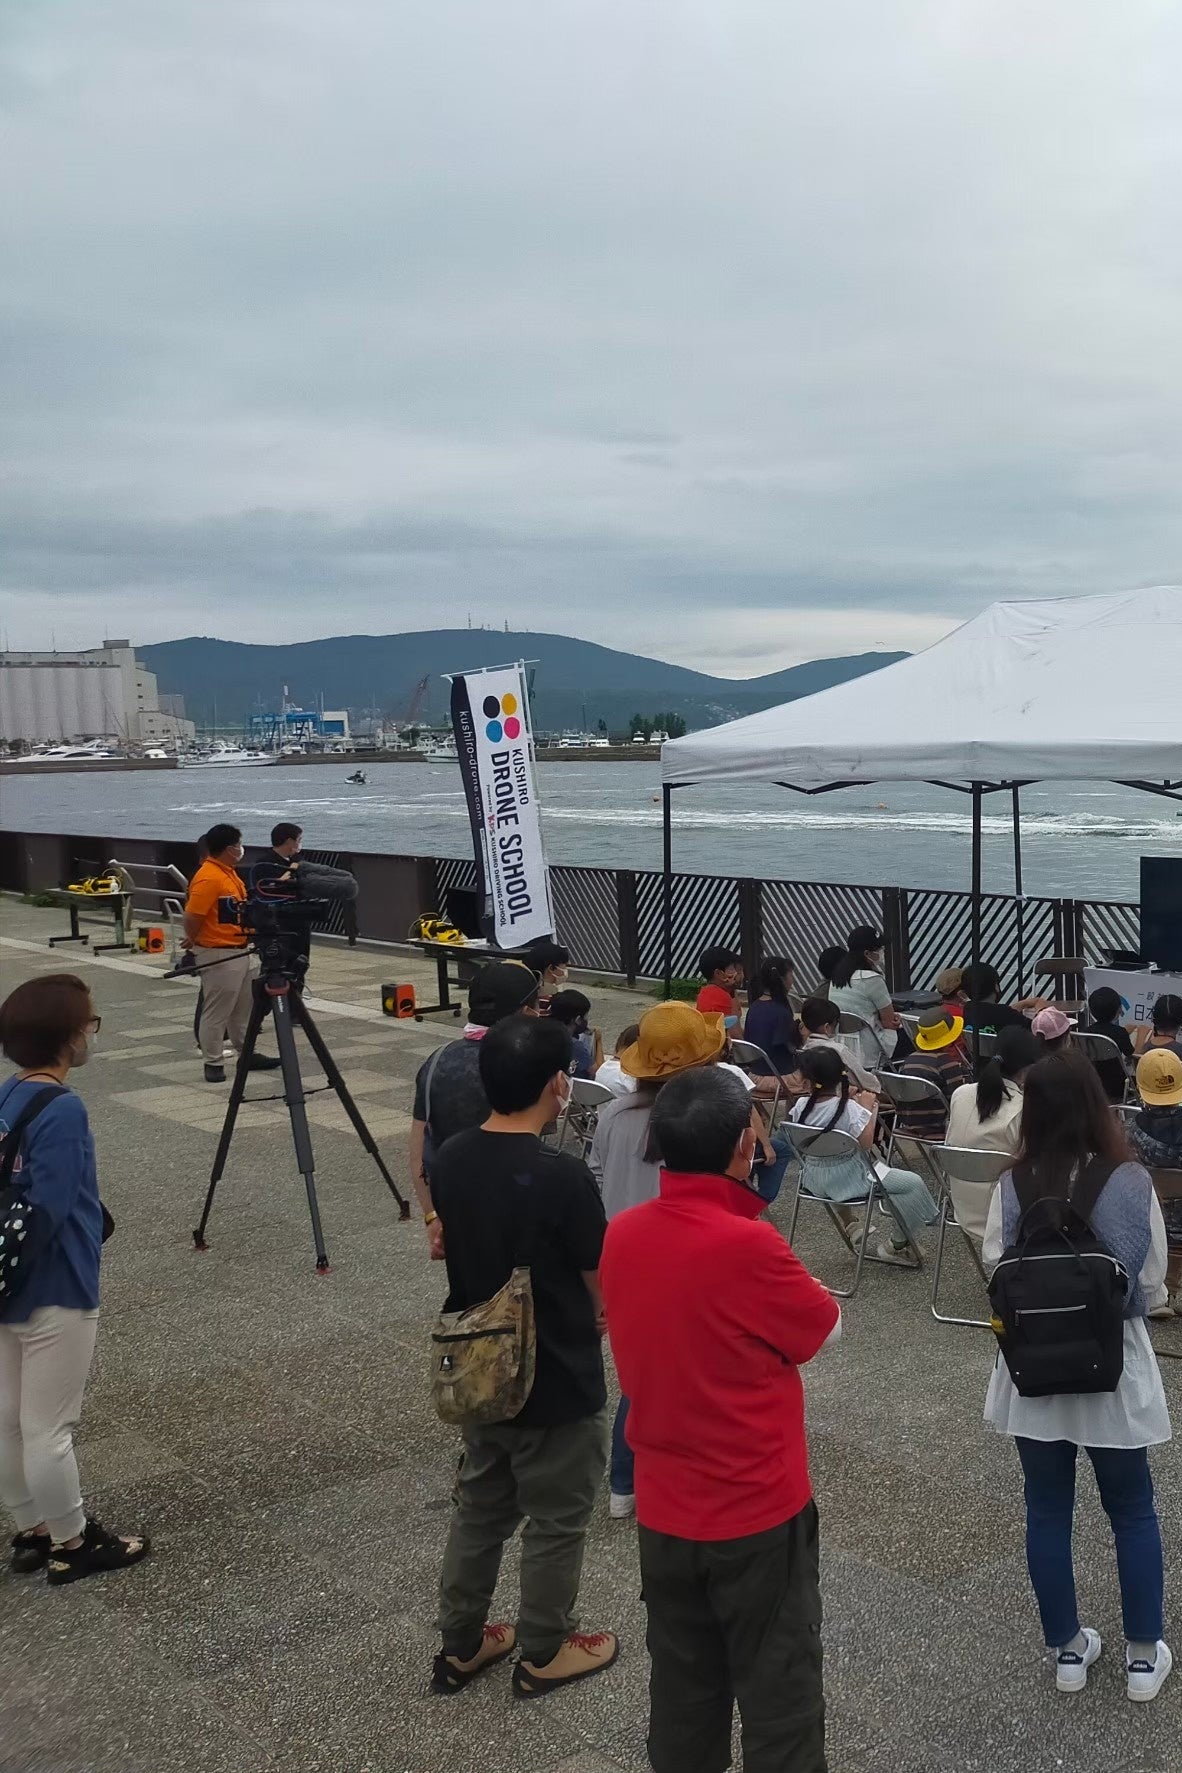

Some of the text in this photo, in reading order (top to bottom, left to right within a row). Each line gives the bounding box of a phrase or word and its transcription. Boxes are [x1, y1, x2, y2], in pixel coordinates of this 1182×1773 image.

[459, 710, 483, 821] kushiro-drone.com
[512, 748, 529, 806] KUSHIRO
[490, 837, 498, 868] KUSHIRO
[494, 869, 502, 899] DRIVING
[498, 900, 507, 927] SCHOOL
[491, 751, 532, 925] DRONE SCHOOL
